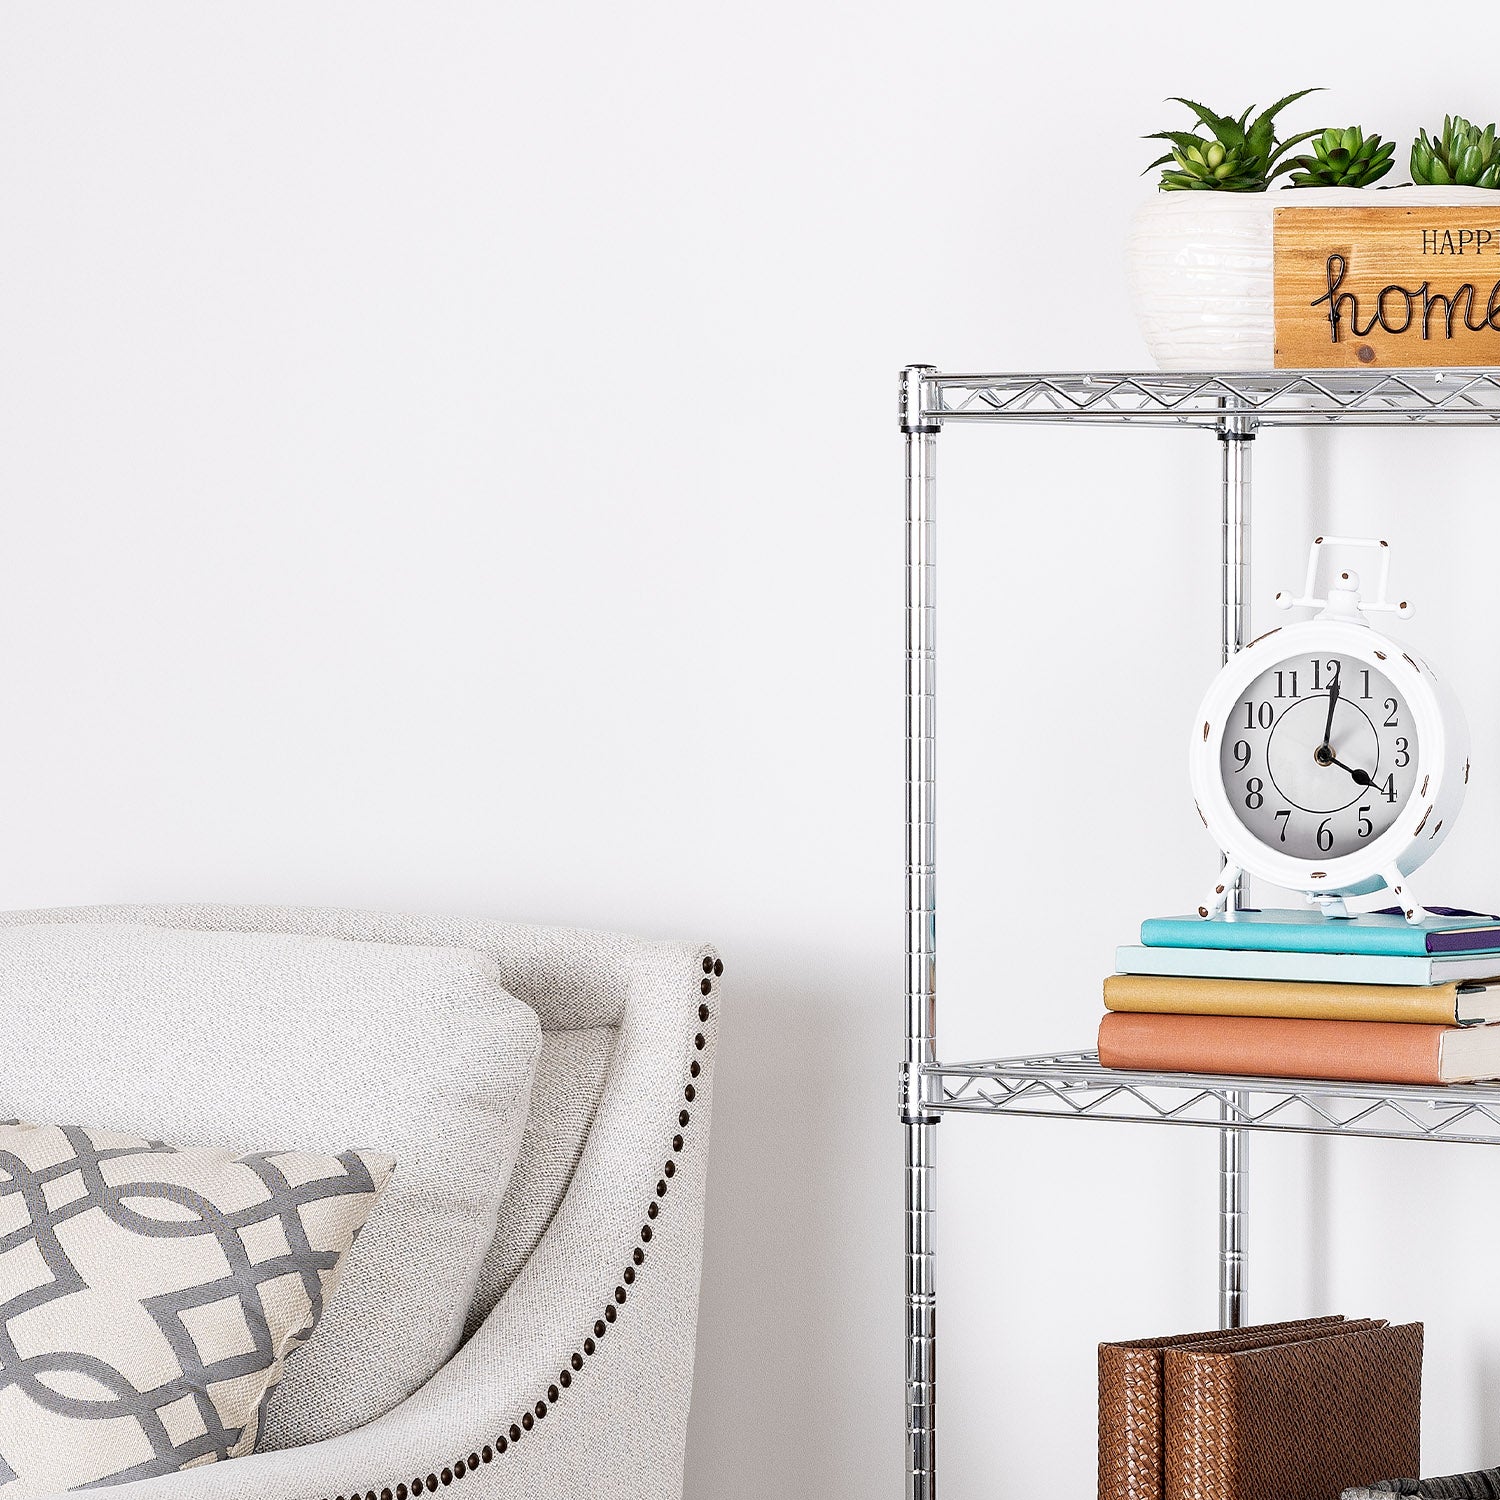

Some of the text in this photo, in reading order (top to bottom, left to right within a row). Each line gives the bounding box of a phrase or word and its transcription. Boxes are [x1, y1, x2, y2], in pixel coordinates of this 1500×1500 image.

[1273, 671, 1301, 698] 11
[1310, 659, 1341, 691] 12
[1359, 670, 1374, 699] 1
[1244, 701, 1274, 730] 10
[1383, 698, 1399, 727] 2
[1233, 740, 1252, 773] 9
[1395, 737, 1410, 767] 3
[1245, 777, 1264, 809] 8
[1380, 773, 1398, 803] 4
[1273, 810, 1291, 842] 7
[1316, 817, 1334, 851] 6
[1357, 805, 1373, 837] 5
